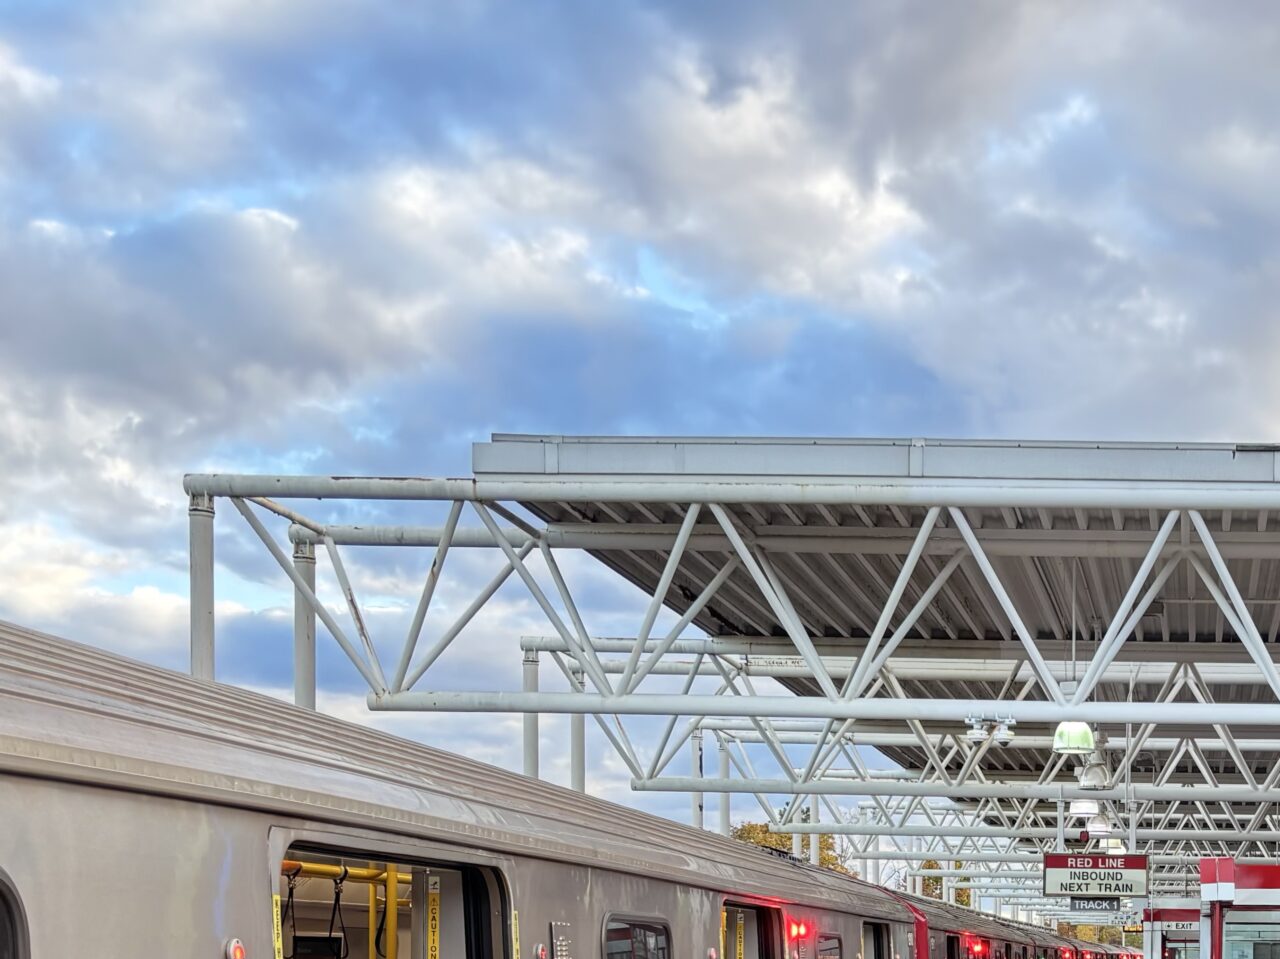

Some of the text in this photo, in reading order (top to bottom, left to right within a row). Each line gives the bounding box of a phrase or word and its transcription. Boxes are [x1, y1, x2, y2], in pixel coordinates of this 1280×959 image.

[1067, 858, 1126, 868] RED LINE
[1069, 871, 1123, 881] INBOUND
[1060, 882, 1133, 893] NEXT TRAIN
[1074, 900, 1118, 910] TRACK 1
